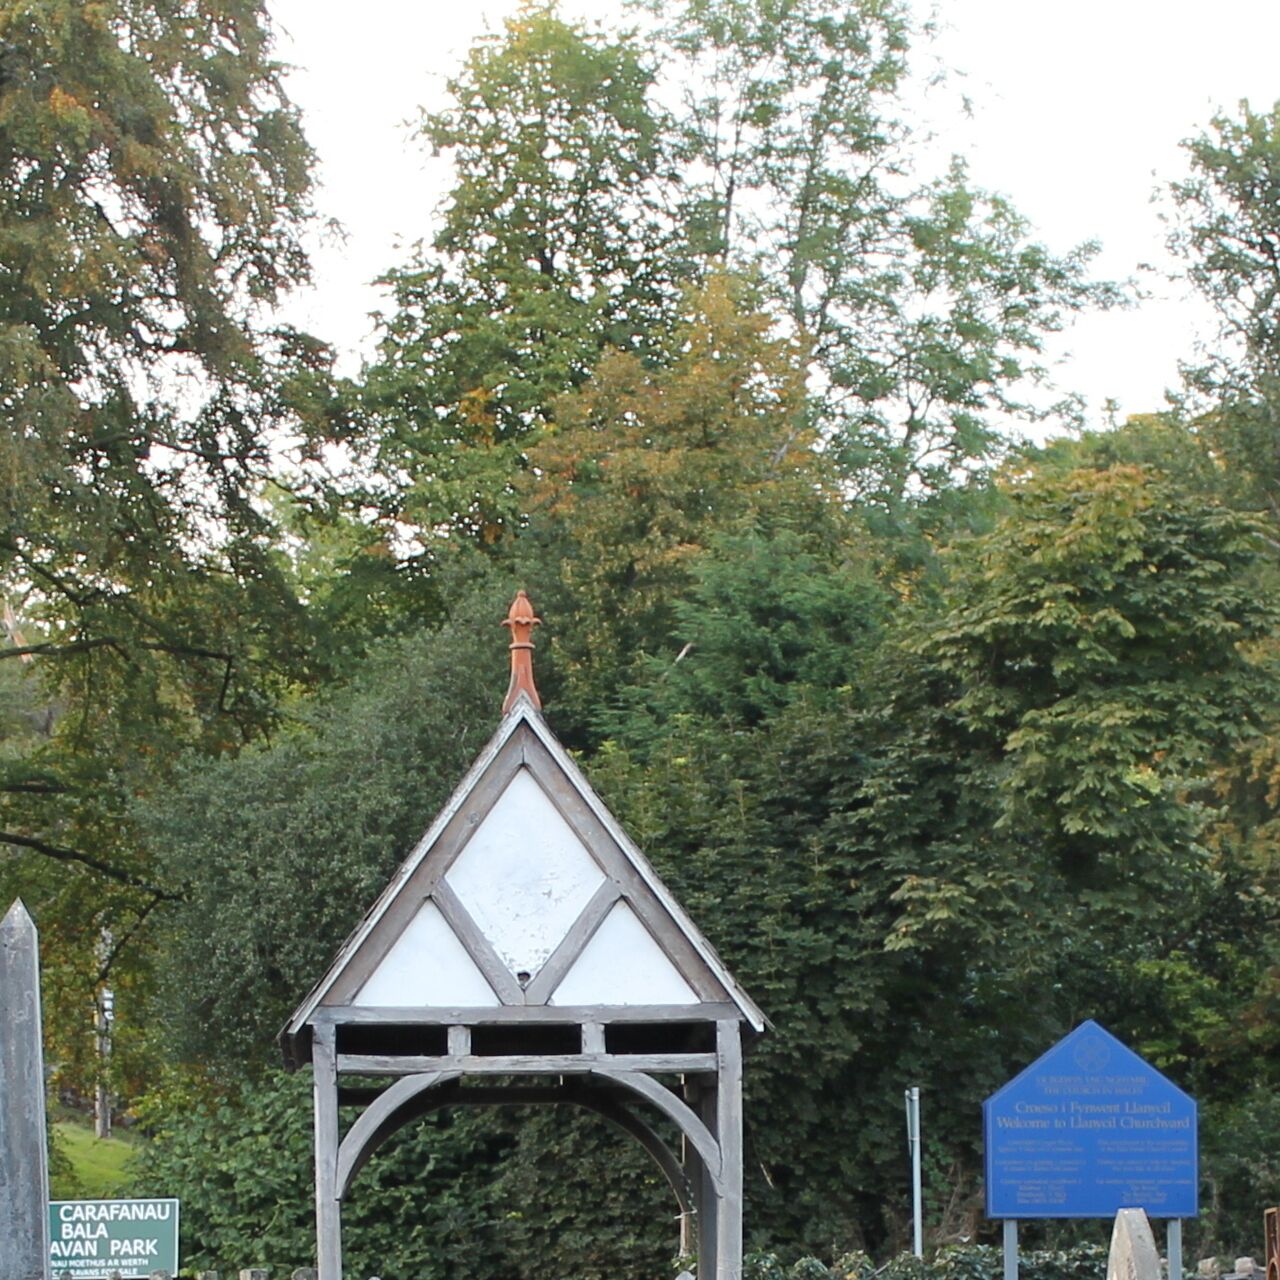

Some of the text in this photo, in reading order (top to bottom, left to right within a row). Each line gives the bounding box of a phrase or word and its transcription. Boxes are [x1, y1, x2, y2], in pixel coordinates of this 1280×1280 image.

[1015, 1101, 1058, 1113] Croeso
[997, 1116, 1050, 1128] Welcome
[1055, 1117, 1067, 1128] to
[60, 1203, 170, 1221] CARAFANAU
[62, 1223, 108, 1239] BALA
[110, 1239, 158, 1255] PARK
[69, 1259, 105, 1267] MOETHUS
[107, 1259, 119, 1267] AR
[121, 1258, 149, 1266] WERTH
